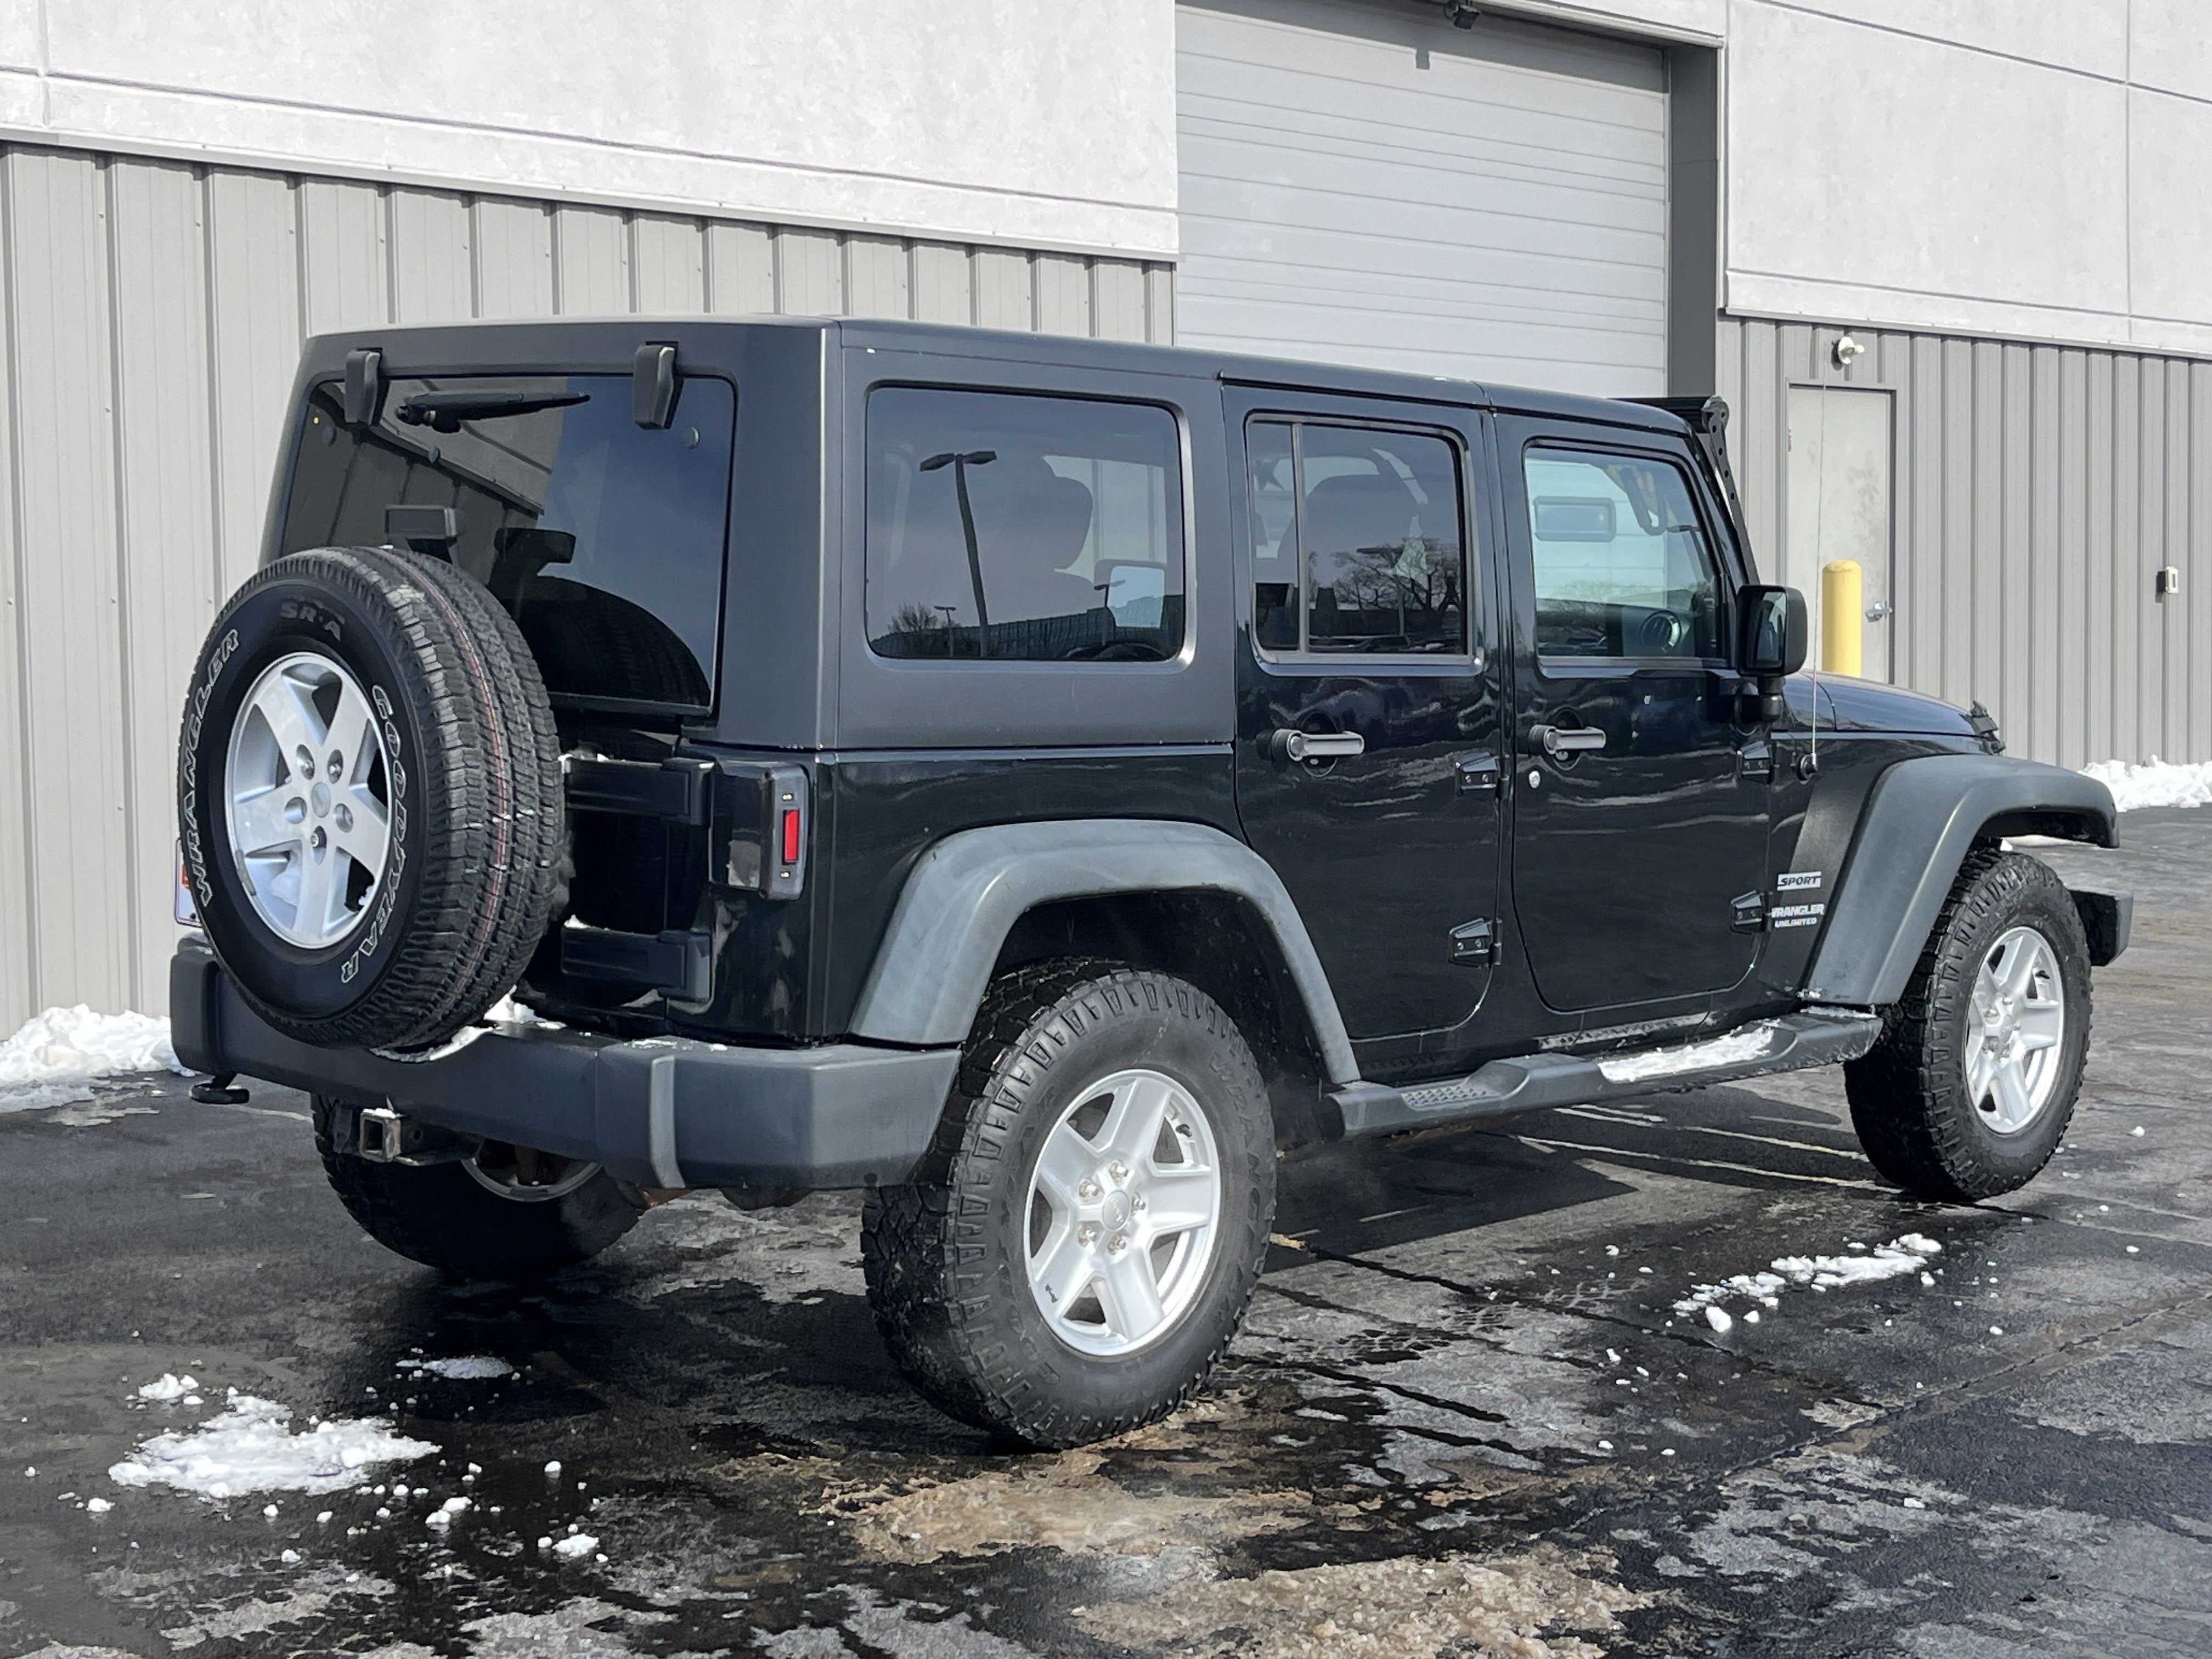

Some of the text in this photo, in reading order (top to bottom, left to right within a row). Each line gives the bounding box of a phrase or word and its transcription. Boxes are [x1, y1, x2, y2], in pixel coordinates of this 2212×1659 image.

[183, 629, 239, 907] WRANGLER
[341, 685, 407, 983] GOODYEAR
[1775, 917, 1817, 928] UNLIMITED
[1781, 876, 1817, 886] SPORT
